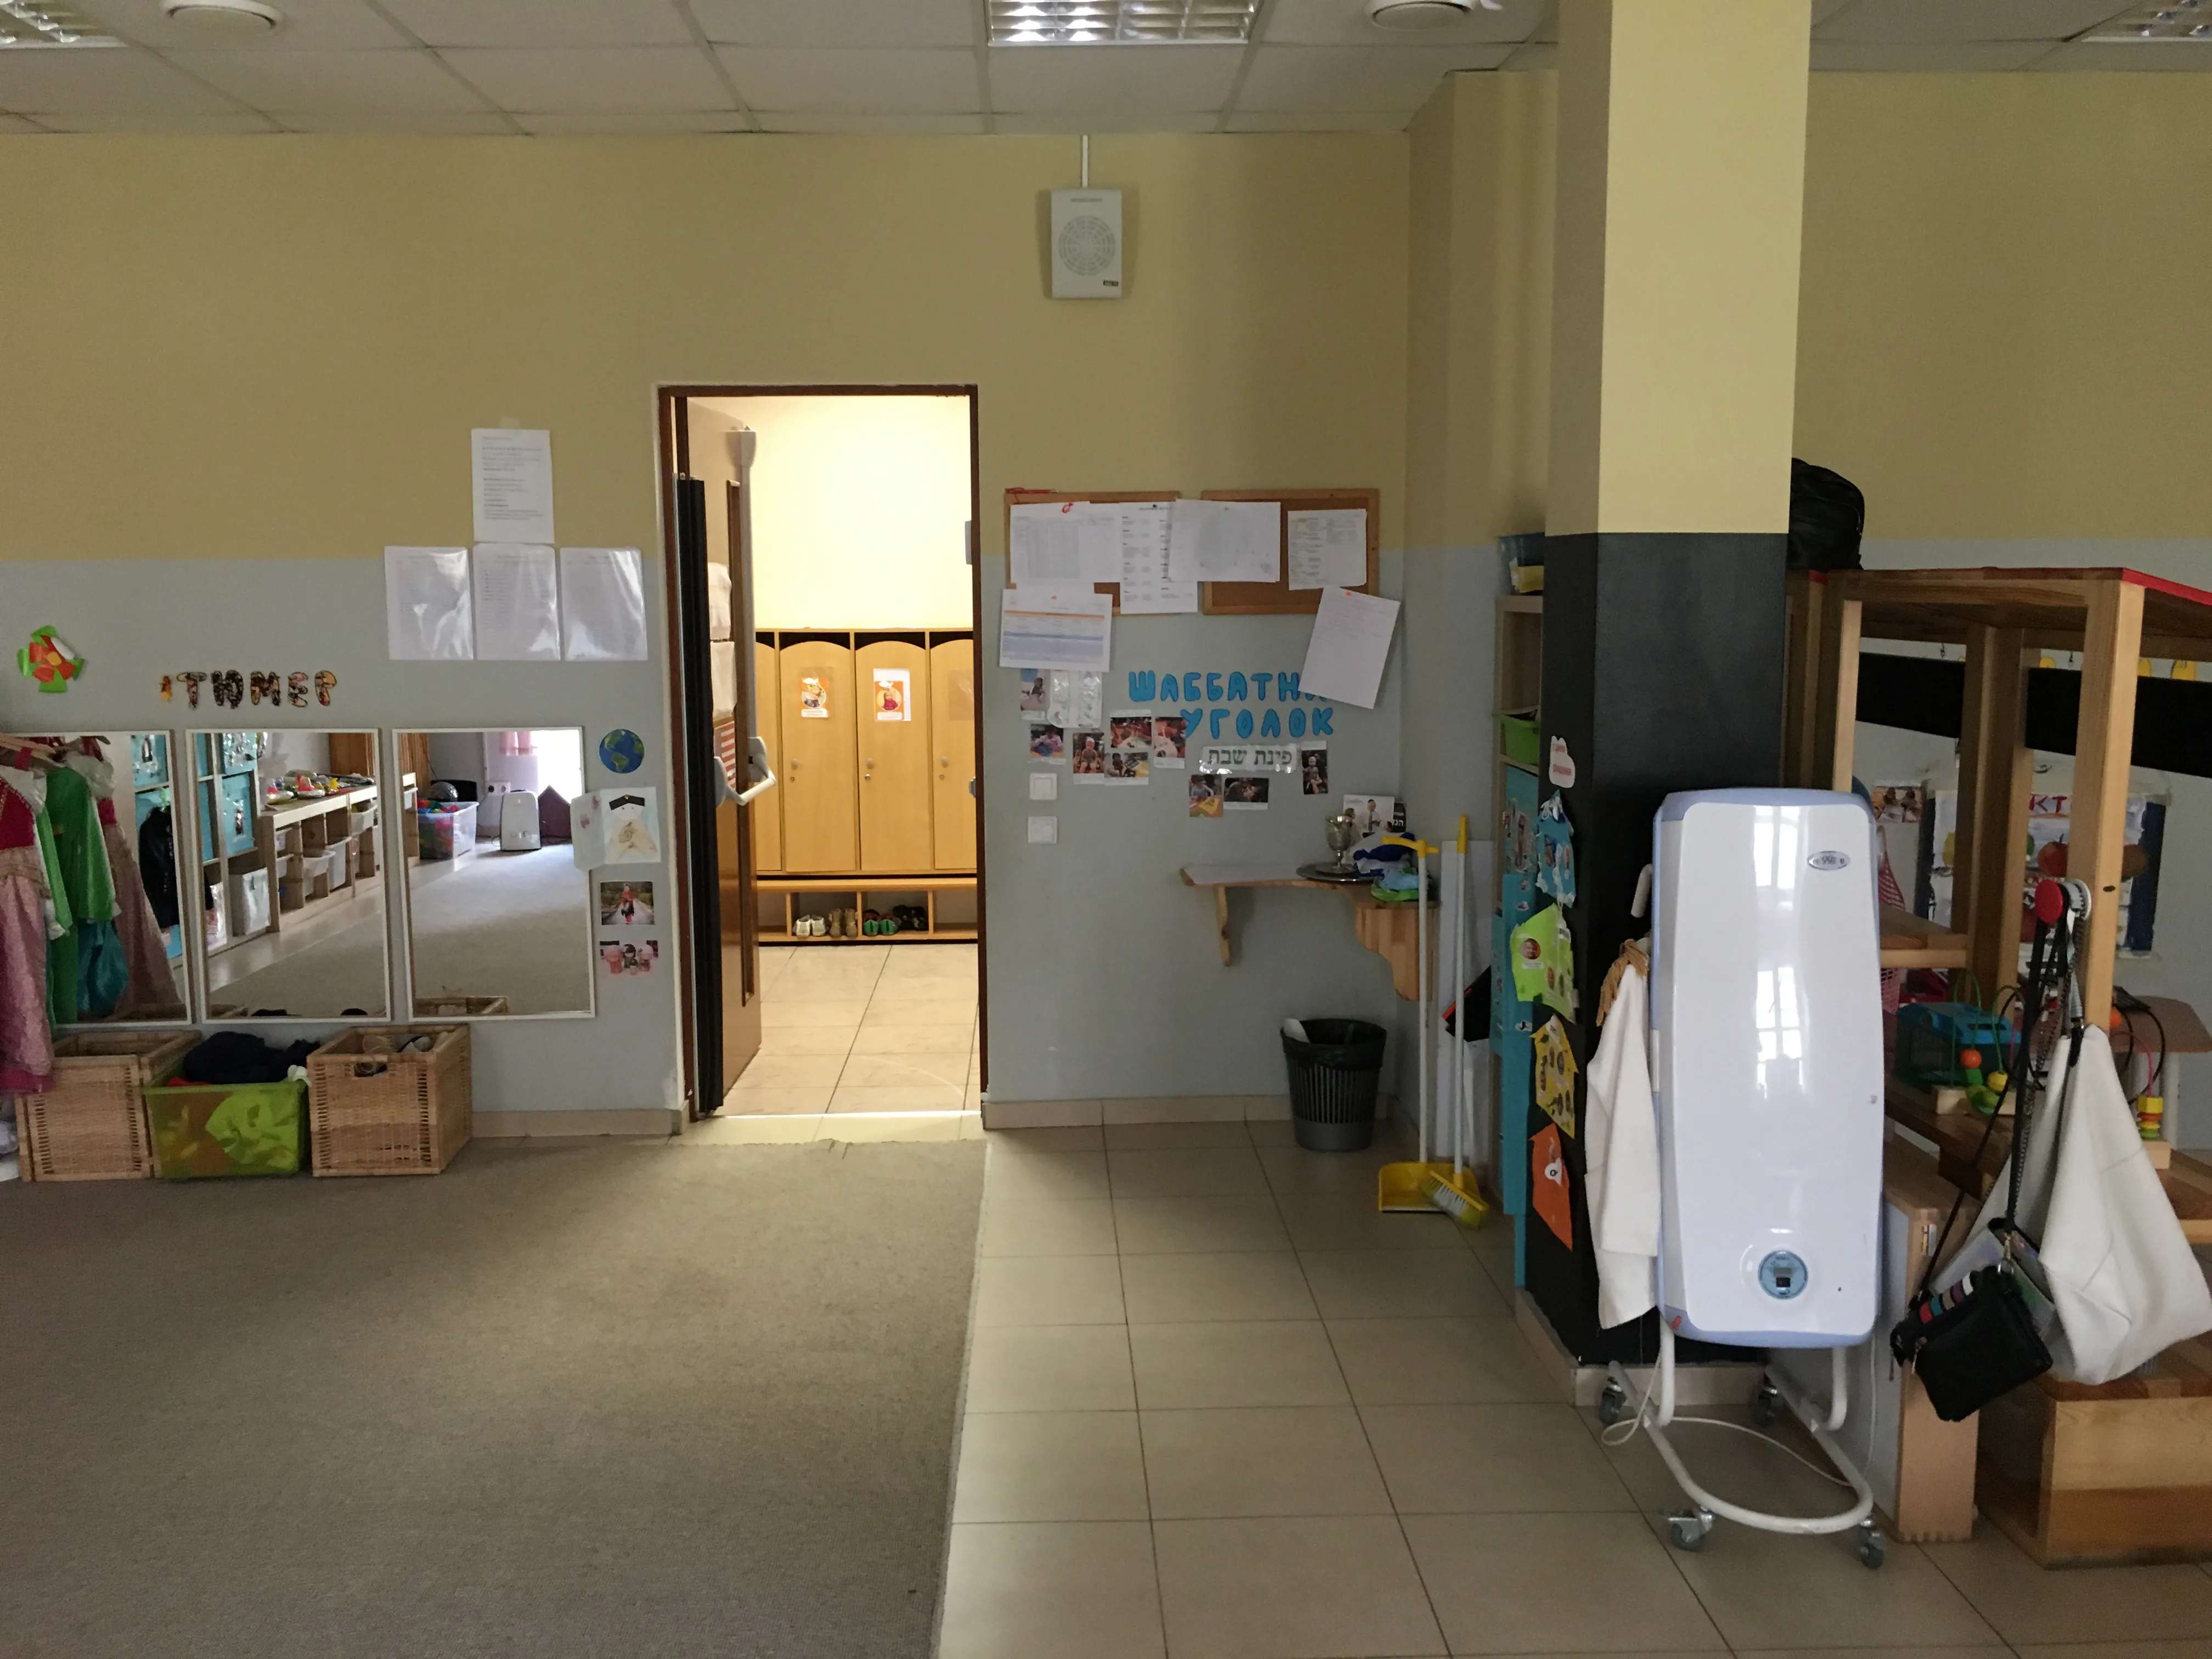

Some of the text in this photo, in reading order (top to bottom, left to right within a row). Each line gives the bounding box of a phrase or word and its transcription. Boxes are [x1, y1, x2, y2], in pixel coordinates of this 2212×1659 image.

[1128, 670, 1327, 702] ШАББАТН
[1180, 707, 1333, 740] УГОЛОК
[1207, 748, 1293, 766] פינת שבת
